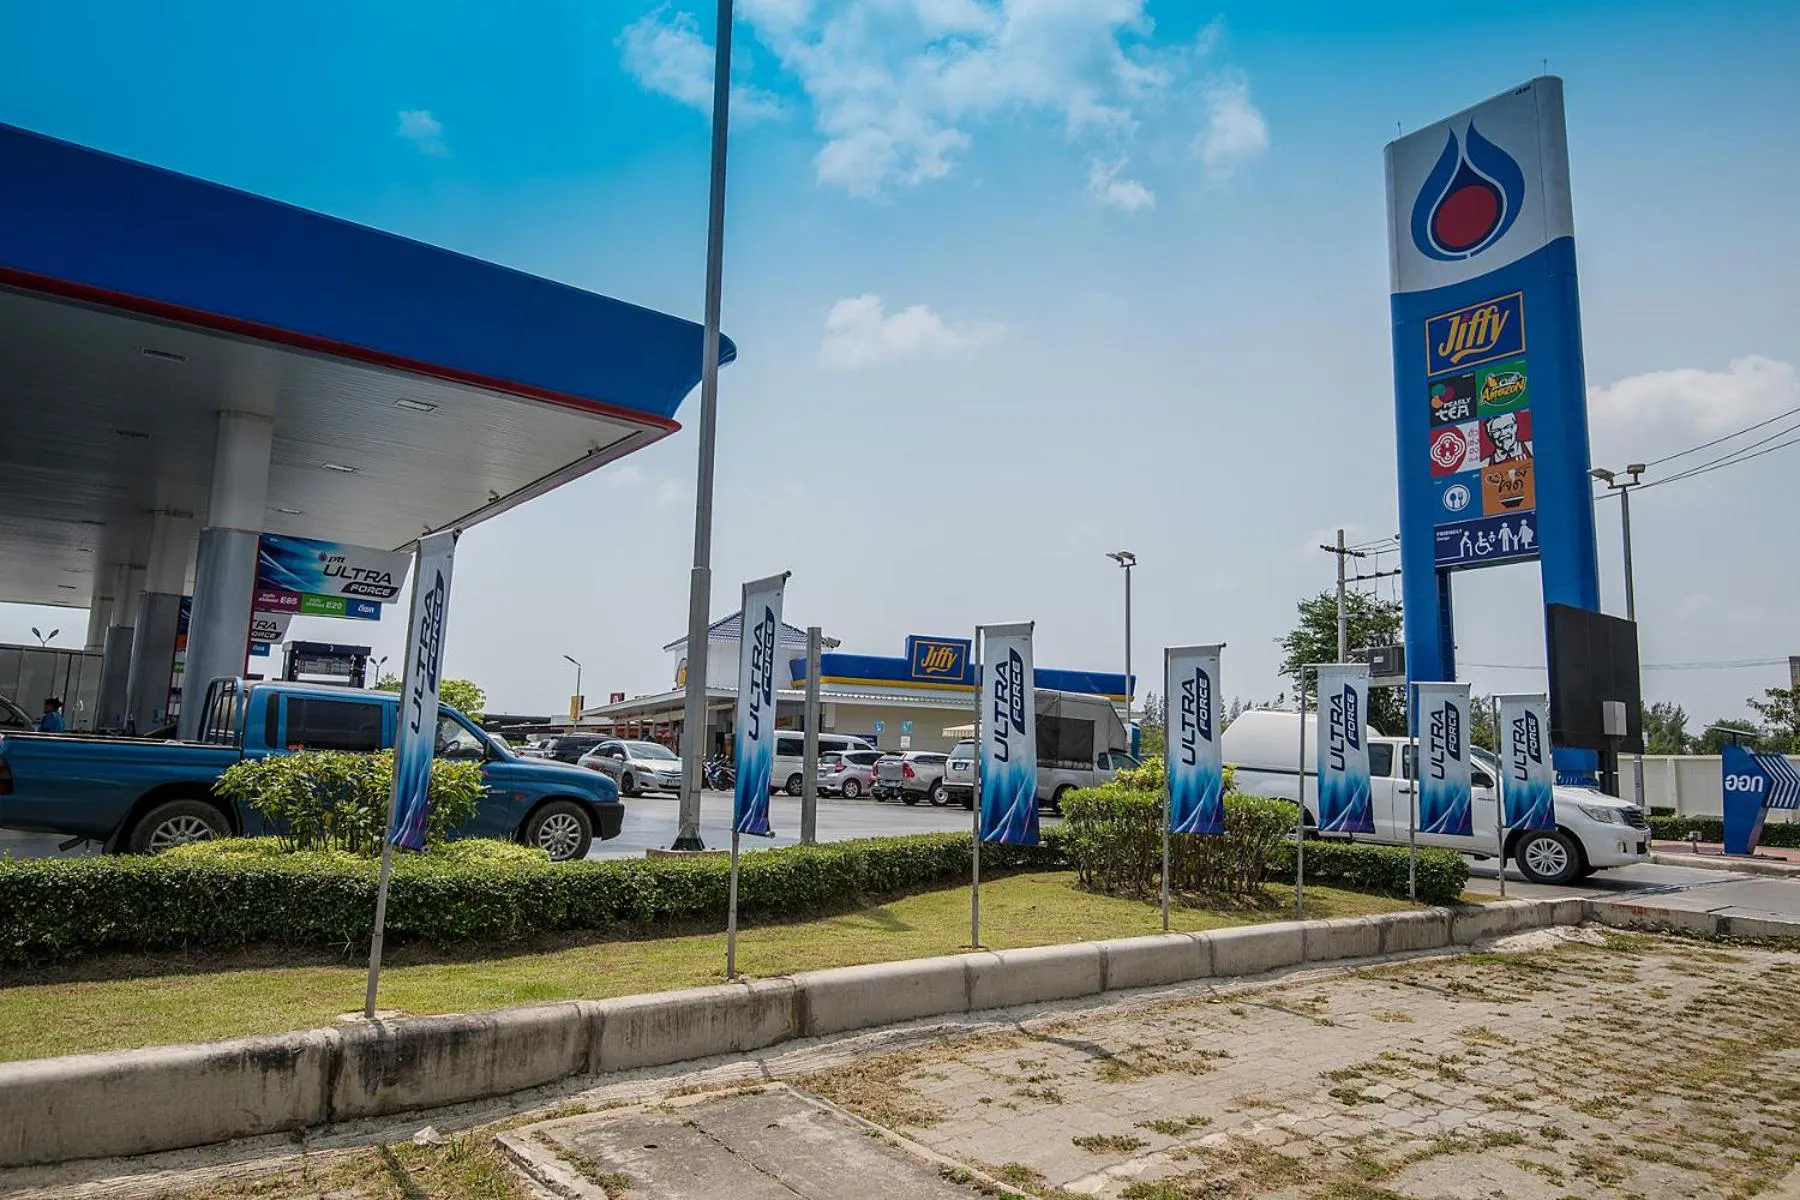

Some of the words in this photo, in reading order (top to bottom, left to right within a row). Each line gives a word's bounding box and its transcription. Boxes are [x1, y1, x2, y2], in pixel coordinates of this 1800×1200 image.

[1438, 305, 1510, 364] Jiffy
[1443, 397, 1472, 408] PEARLY
[323, 564, 393, 585] ULTRA
[350, 584, 391, 596] FORCE
[428, 587, 443, 675] FORCE
[763, 621, 773, 692] FORCE
[920, 645, 958, 673] Jiffy
[411, 589, 434, 734] ULTRA
[748, 622, 764, 741] ULTRA
[1012, 660, 1021, 722] FORCE
[994, 661, 1009, 762] ULTRA
[1182, 679, 1196, 766] ULTRA
[1199, 677, 1208, 731] FORCE
[1330, 694, 1345, 772] ULTRA
[1347, 693, 1357, 740] FORCE
[1448, 709, 1457, 752] FORCE
[1431, 710, 1445, 780] ULTRA
[1513, 718, 1528, 781] ULTRA
[1529, 717, 1538, 756] FORCE
[1725, 774, 1763, 792] ออก
